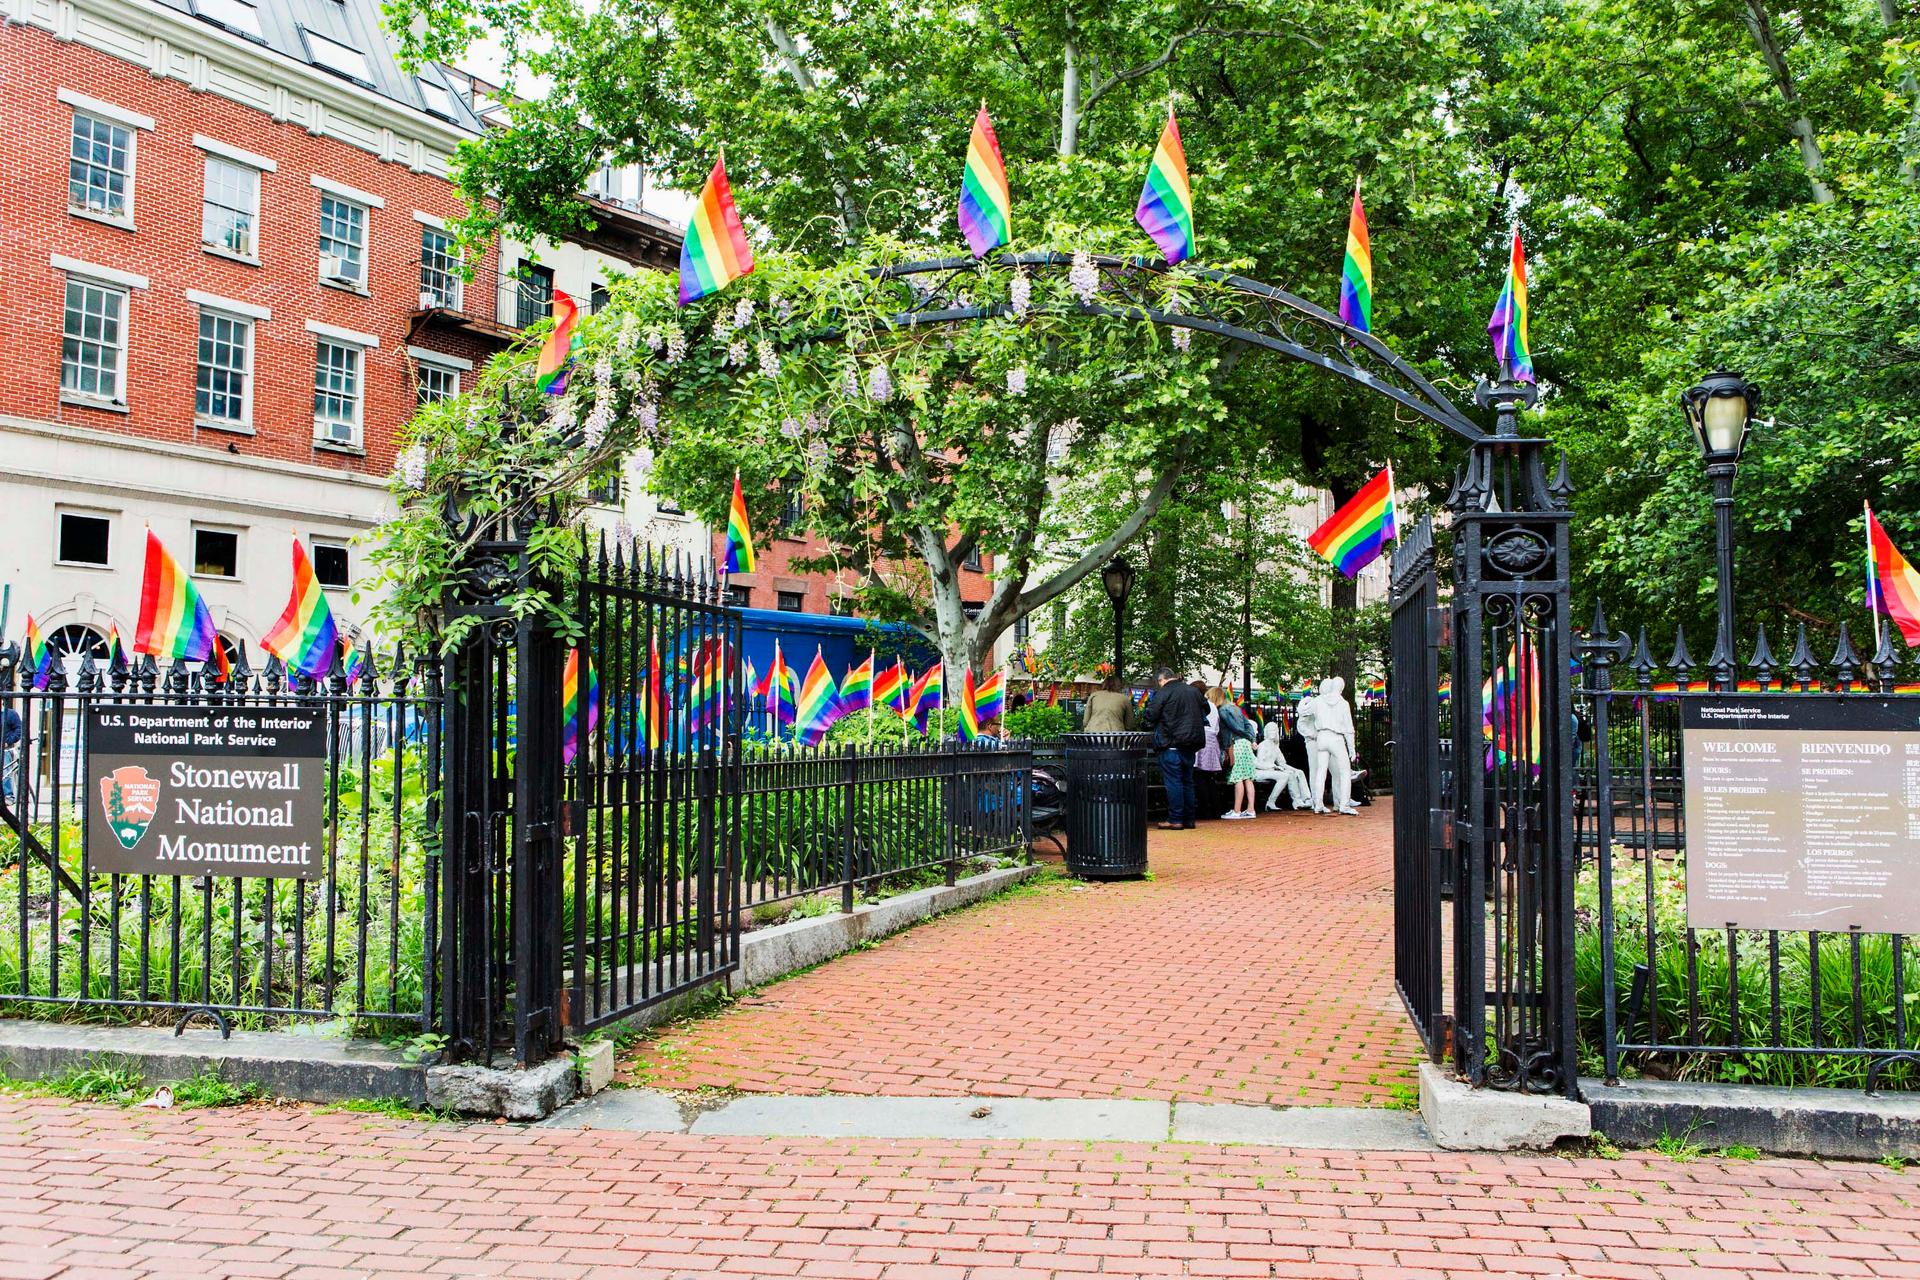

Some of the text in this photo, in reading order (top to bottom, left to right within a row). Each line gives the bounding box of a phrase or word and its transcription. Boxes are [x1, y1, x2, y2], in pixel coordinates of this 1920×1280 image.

[100, 715, 312, 730] U.S. Department of the Interior
[134, 732, 276, 746] National Park Service
[1702, 742, 1777, 753] WELCOME
[1801, 743, 1891, 755] BIENVENIDO
[170, 761, 300, 790] Stonewall
[1703, 766, 1732, 774] HOURS:
[175, 798, 294, 827] National
[156, 834, 311, 865] Monument
